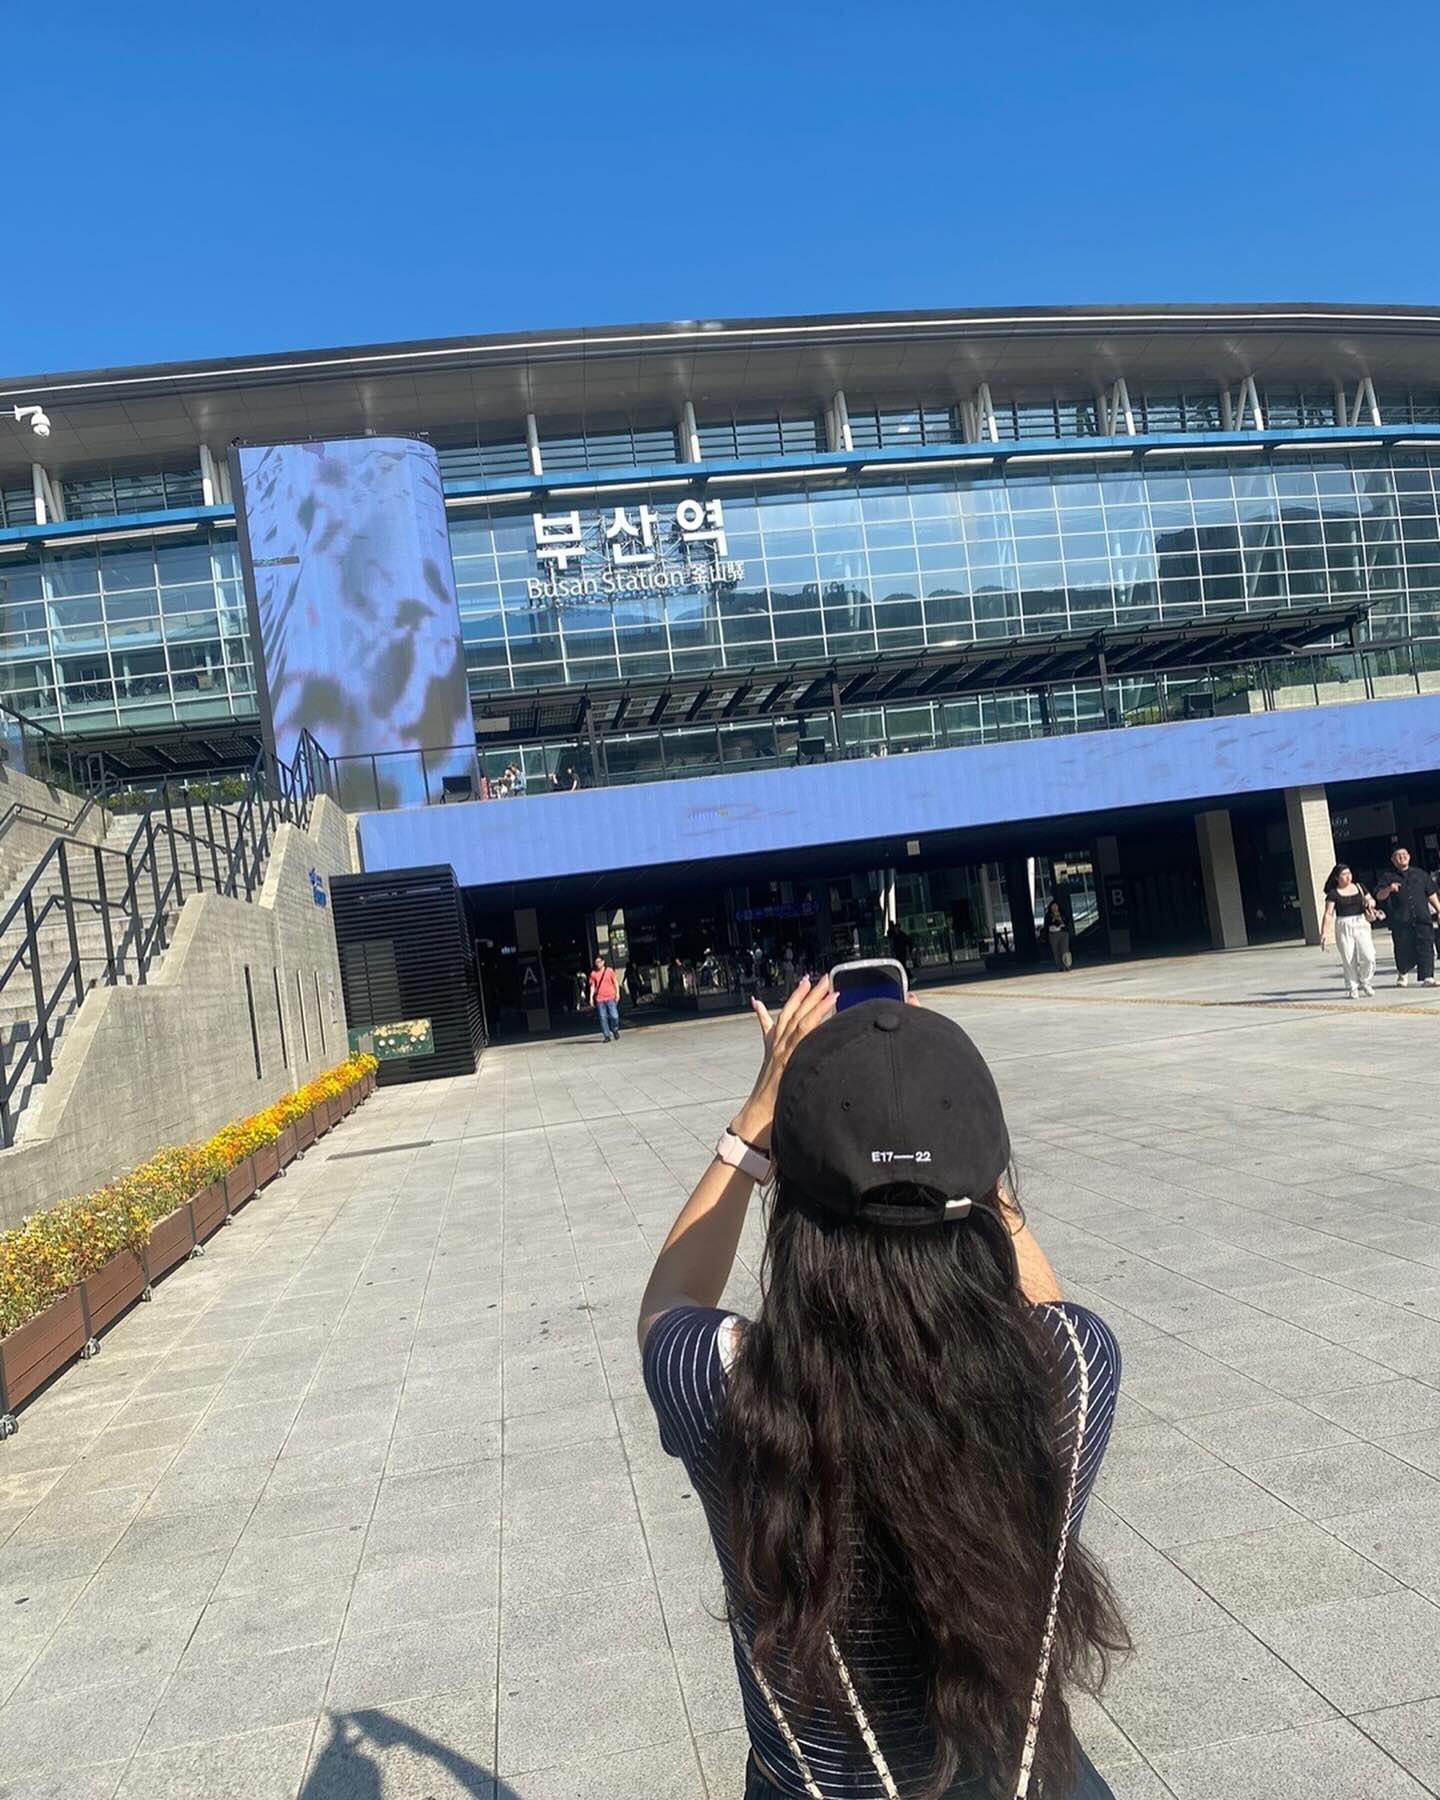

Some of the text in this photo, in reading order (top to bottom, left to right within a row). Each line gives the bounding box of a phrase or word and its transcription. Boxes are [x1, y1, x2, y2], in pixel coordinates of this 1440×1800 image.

[533, 499, 728, 569] 부산역
[527, 561, 745, 599] Busan Station 釜山驛
[1112, 889, 1125, 906] B
[523, 967, 538, 984] A
